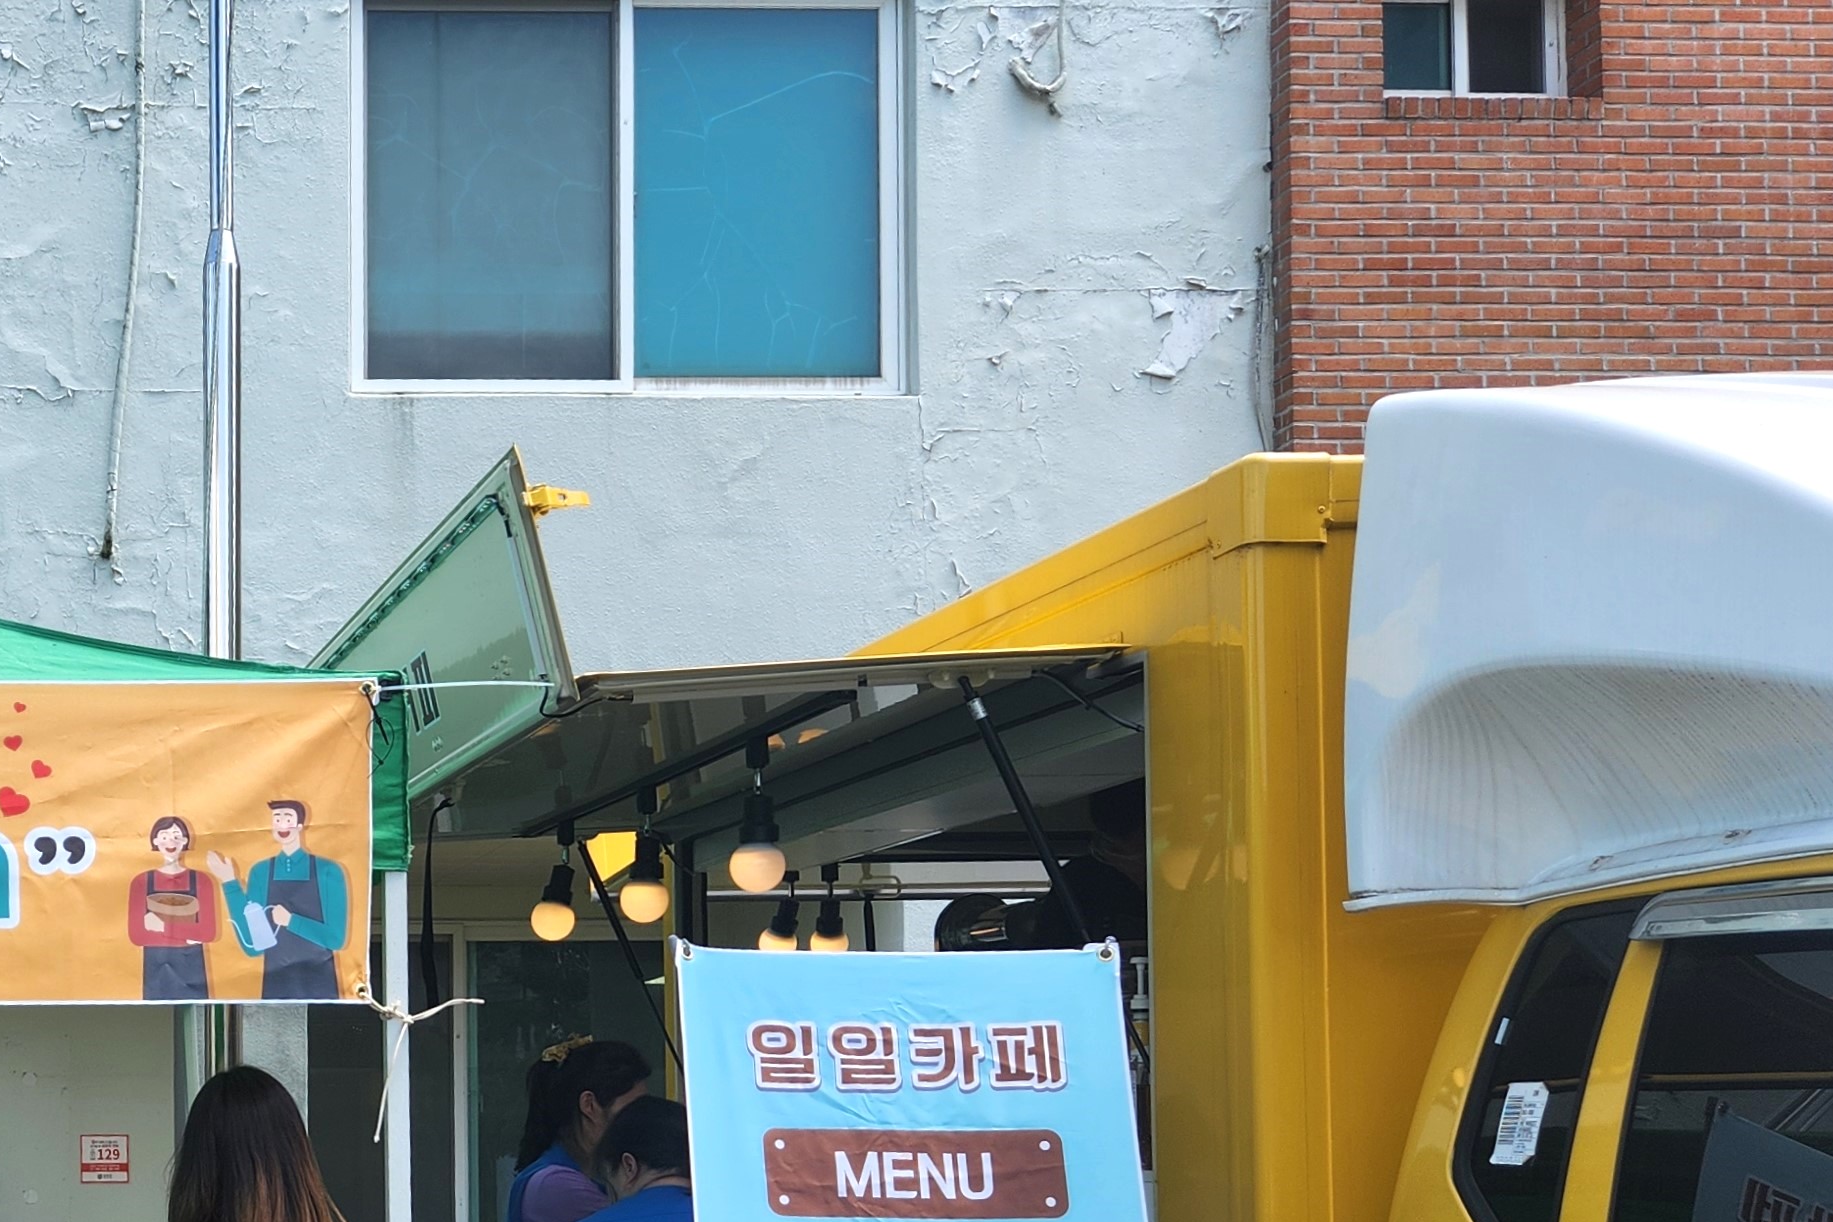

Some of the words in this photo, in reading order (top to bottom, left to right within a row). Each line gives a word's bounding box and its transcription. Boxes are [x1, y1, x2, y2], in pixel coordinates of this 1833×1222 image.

[746, 1020, 1069, 1092] 일일카페
[97, 1148, 120, 1160] 129
[834, 1150, 995, 1200] MENU
